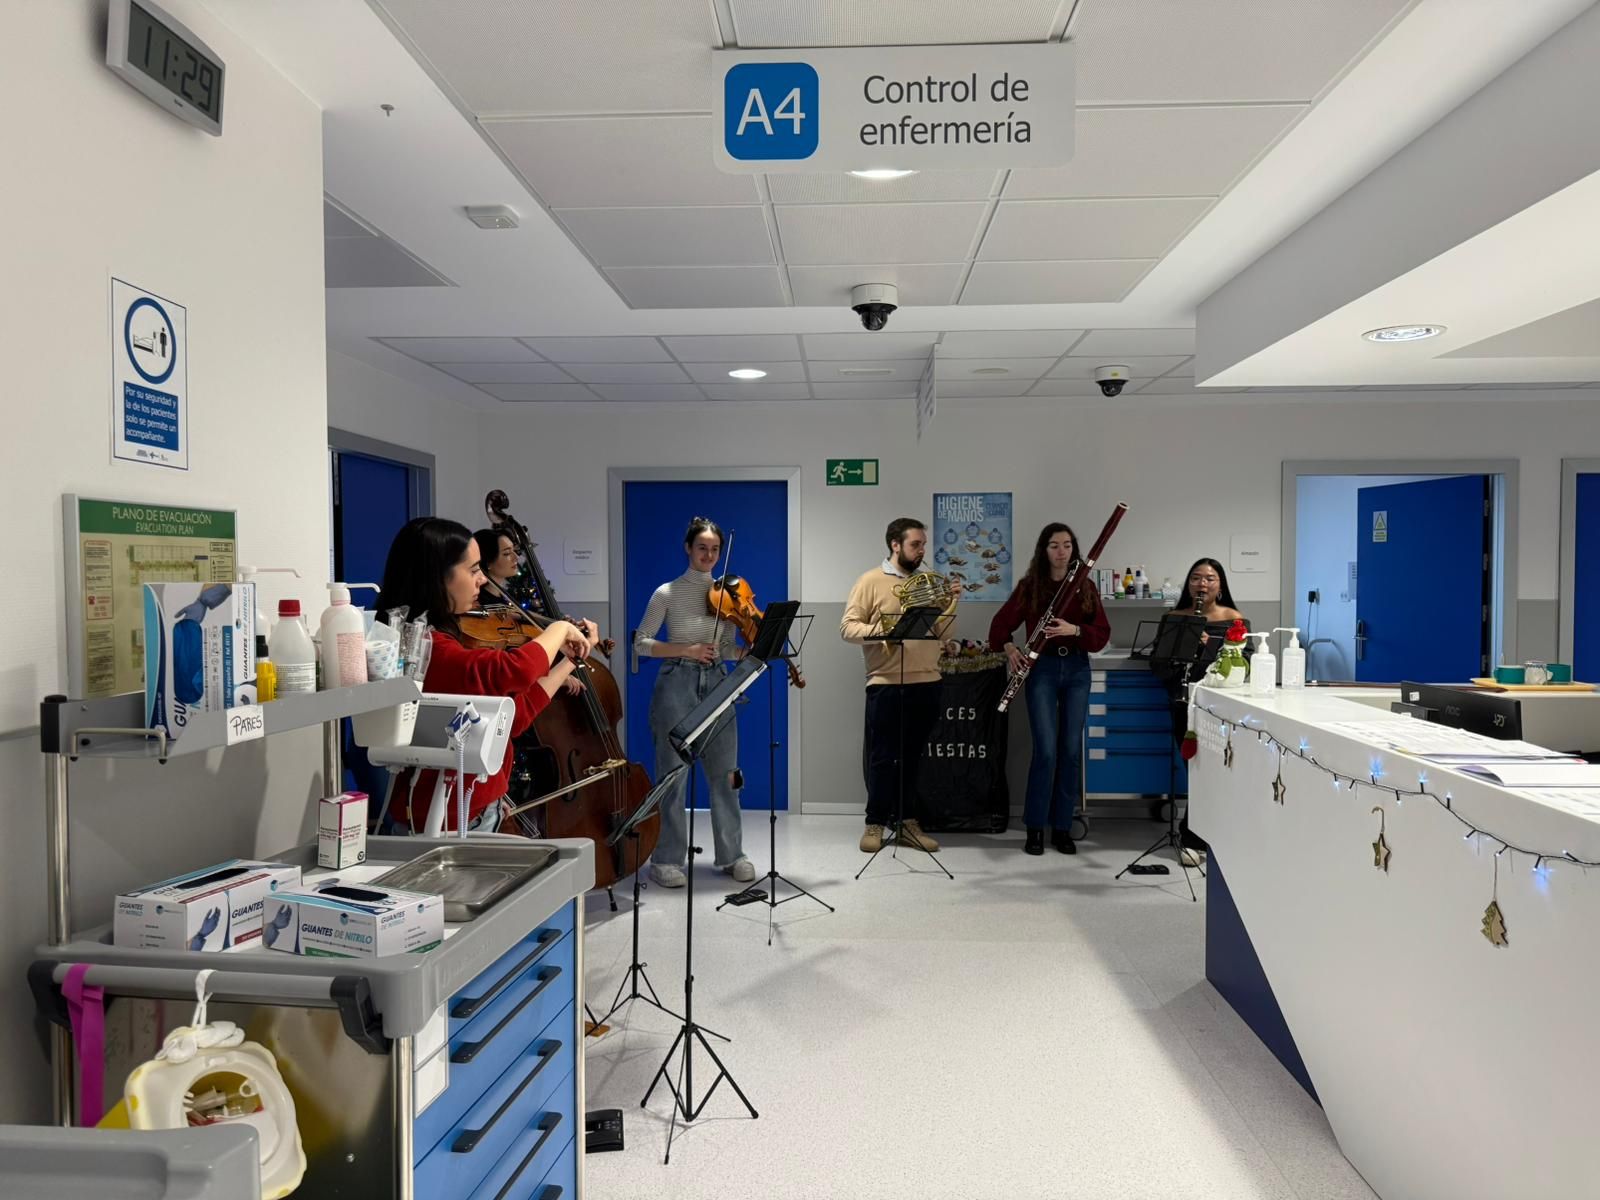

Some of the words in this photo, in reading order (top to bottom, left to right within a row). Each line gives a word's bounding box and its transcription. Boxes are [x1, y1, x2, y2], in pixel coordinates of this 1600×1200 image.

[145, 25, 213, 112] 11:29
[863, 73, 977, 104] Control
[990, 72, 1029, 102] de
[735, 87, 806, 136] A4
[859, 112, 1031, 146] enfermería
[125, 386, 136, 396] Por
[136, 391, 144, 399] su
[145, 393, 172, 406] seguridad
[172, 401, 177, 409] y
[125, 399, 131, 409] la
[132, 402, 140, 412] de
[141, 404, 150, 414] los
[150, 408, 176, 420] pacientes
[139, 417, 146, 426] se
[147, 419, 168, 431] permite
[169, 425, 176, 433] un
[937, 496, 984, 510] HIGIENE
[112, 507, 144, 521] PLANO
[146, 509, 159, 522] DE
[160, 509, 212, 525] EVACUACIÓN
[938, 510, 948, 519] DE
[948, 510, 984, 522] MANOS
[135, 521, 178, 534] EVACUATION
[178, 524, 194, 535] PLAN
[946, 707, 976, 720] CES
[230, 715, 262, 736] PARES
[928, 742, 986, 758] IESTAS
[119, 902, 144, 911] GUANTES
[232, 900, 264, 919] GUANTES
[301, 923, 333, 937] GUANTES
[334, 929, 344, 939] DE
[345, 931, 373, 944] NITRILO
